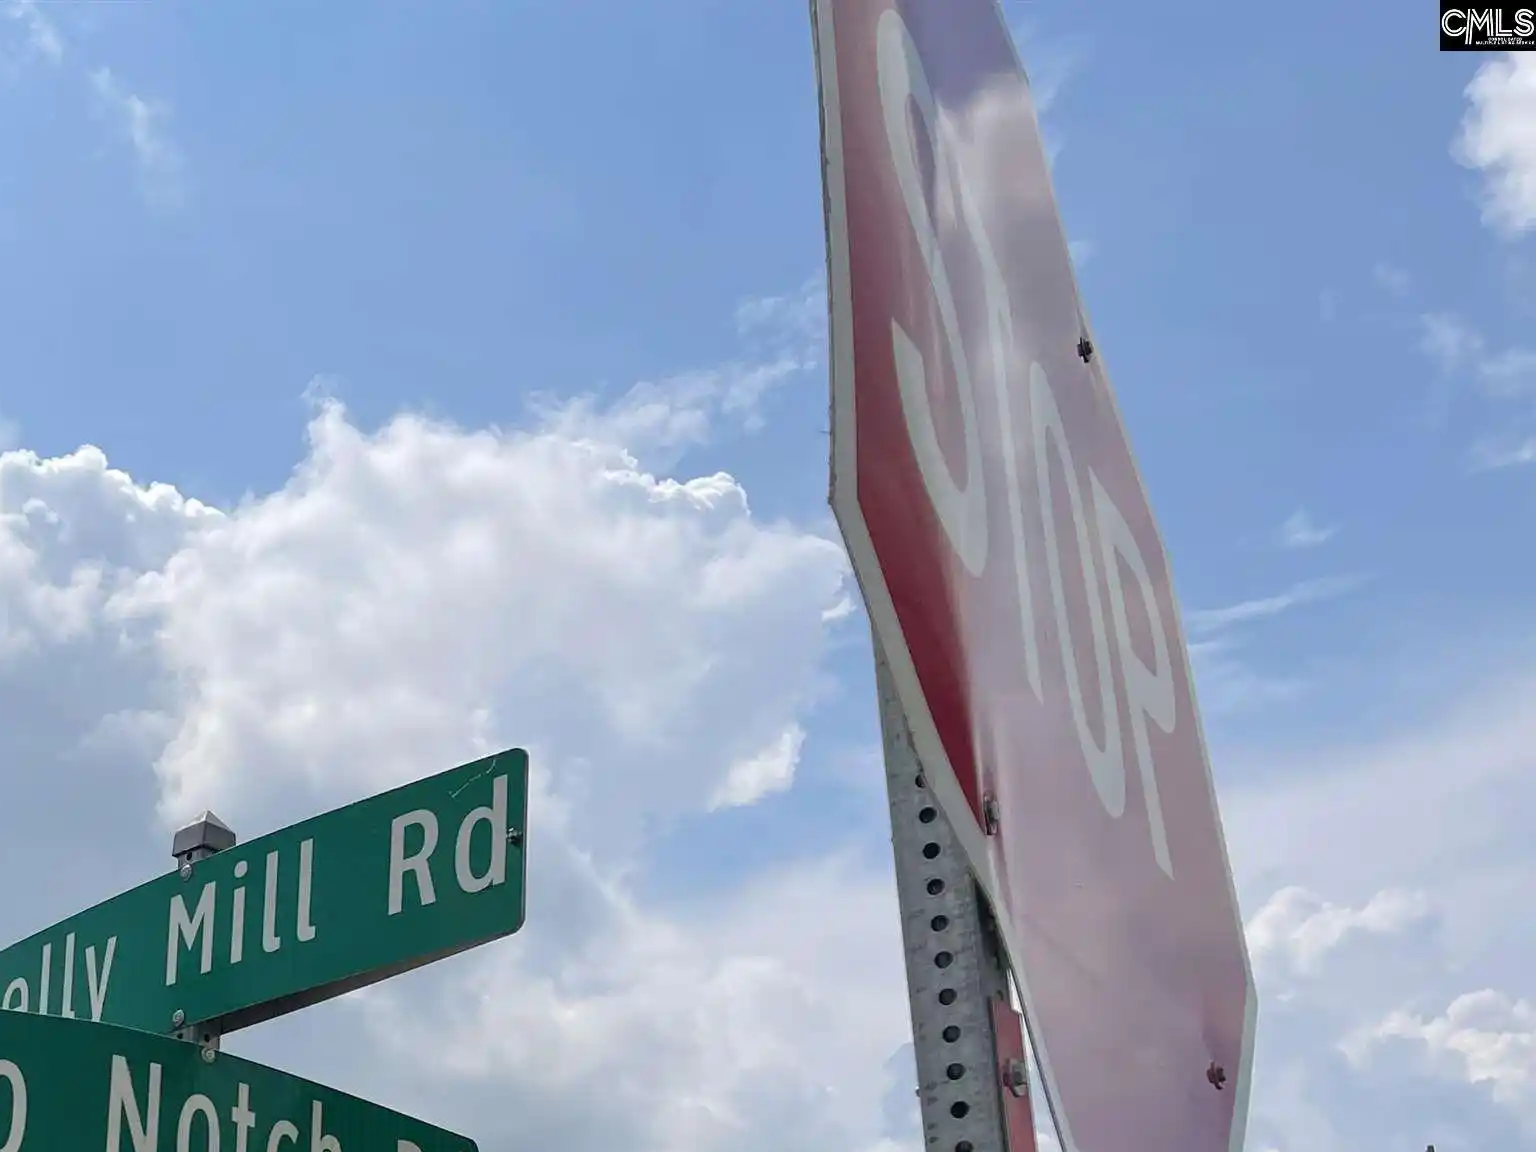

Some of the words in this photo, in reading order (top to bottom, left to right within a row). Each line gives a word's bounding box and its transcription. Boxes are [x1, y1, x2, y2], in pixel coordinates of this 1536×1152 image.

[876, 8, 1175, 881] STOP
[164, 838, 317, 986] Mill
[387, 773, 509, 916] Rd
